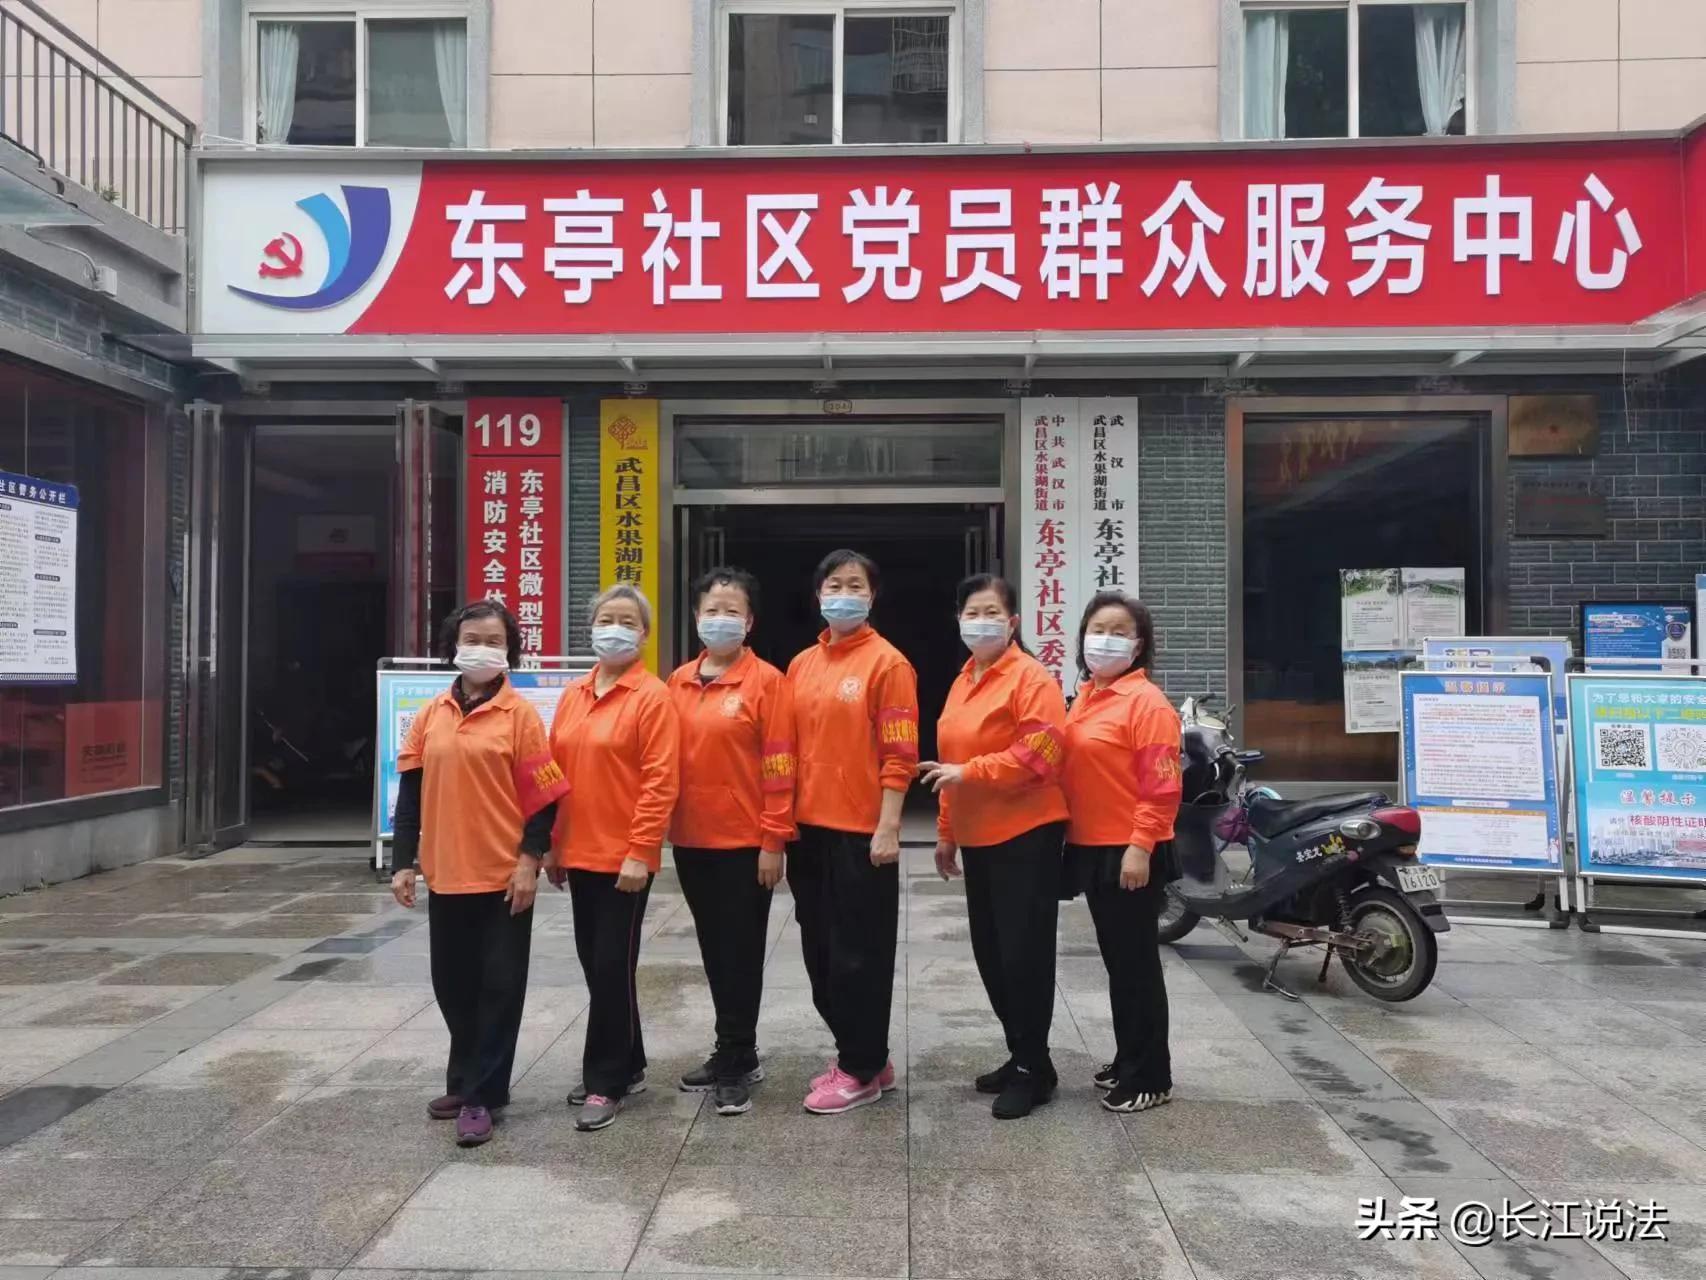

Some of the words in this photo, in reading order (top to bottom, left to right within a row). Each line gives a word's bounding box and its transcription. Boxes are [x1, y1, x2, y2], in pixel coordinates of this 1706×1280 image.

[445, 173, 1642, 306] 东亭社区党员群众服务中心
[475, 413, 541, 447] 119
[1034, 415, 1049, 511] 武昌区水果湖街道
[1093, 415, 1107, 511] 武昌区水果湖街道
[615, 457, 642, 588] 武昌区水果湖街
[1093, 518, 1125, 593] 东亭社
